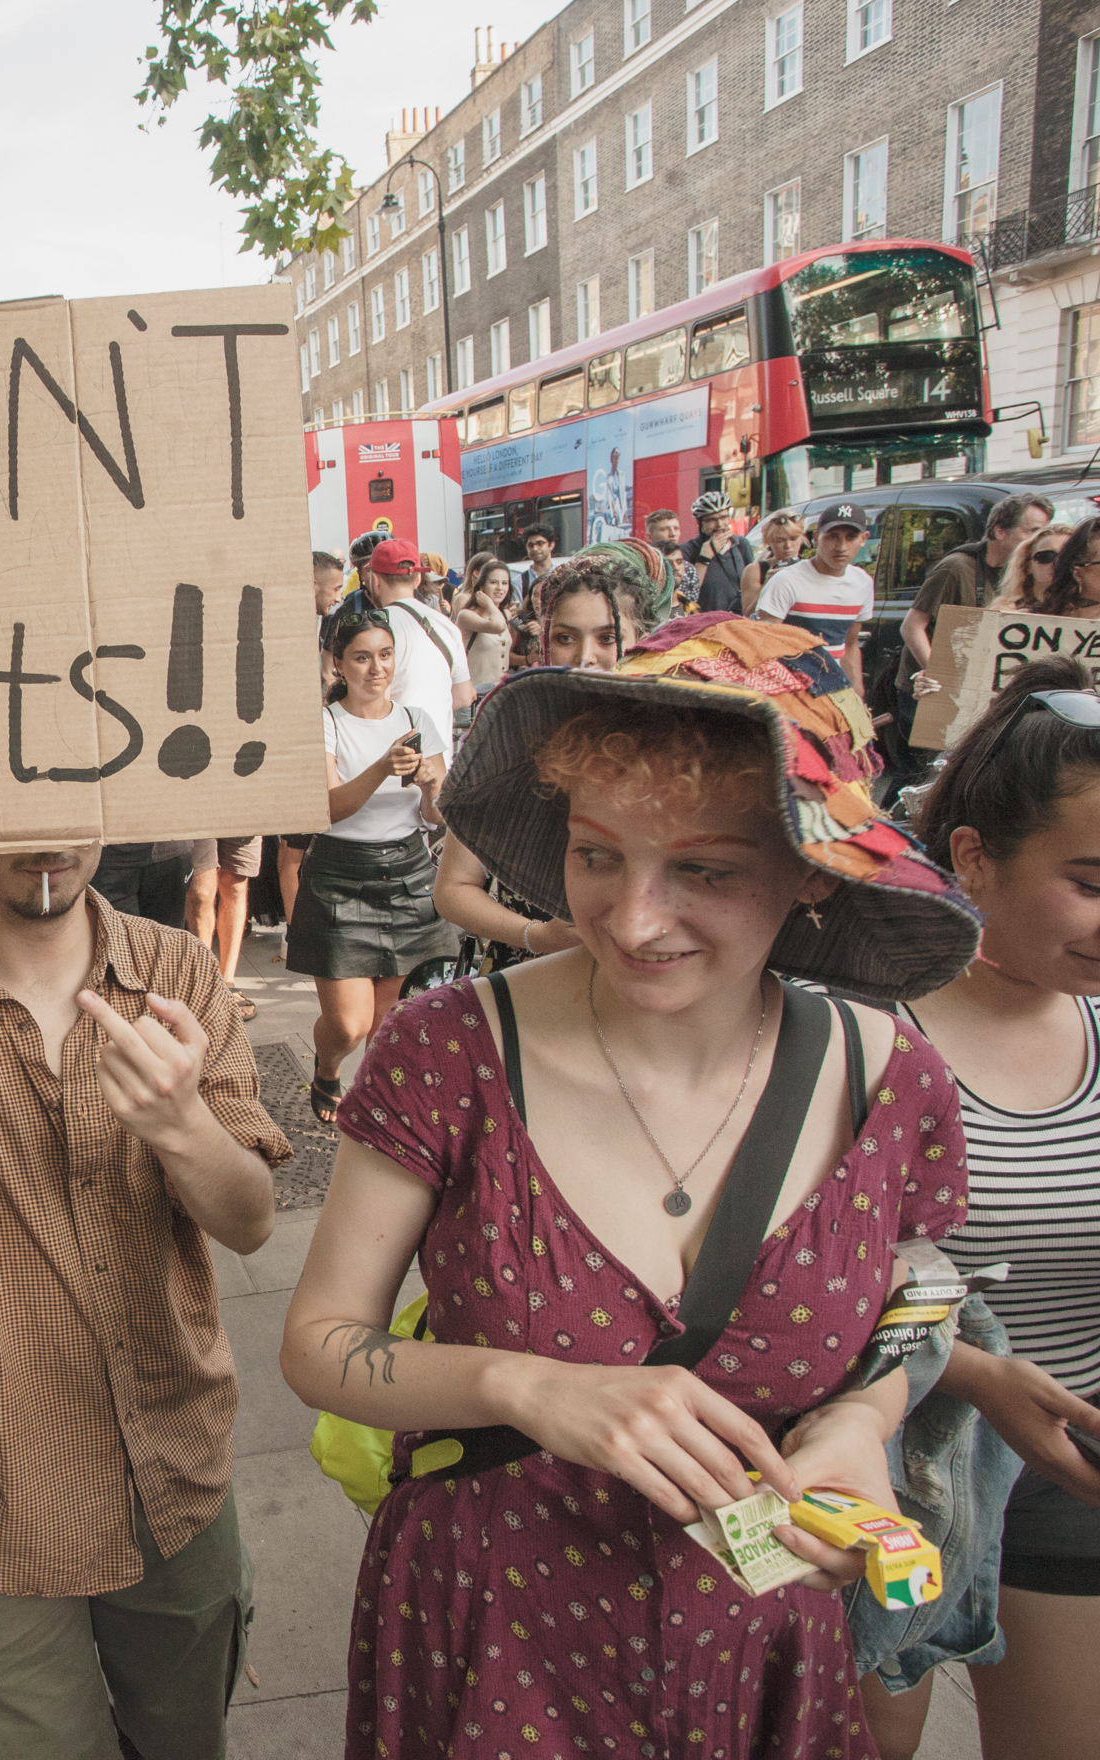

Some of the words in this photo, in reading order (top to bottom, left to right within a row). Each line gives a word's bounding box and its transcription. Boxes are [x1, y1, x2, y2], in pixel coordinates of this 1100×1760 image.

[810, 387, 853, 405] Russell
[857, 385, 899, 404] Square
[923, 376, 951, 402] 14
[639, 415, 677, 431] GUNWHARF
[678, 407, 702, 422] QUAYS
[945, 410, 977, 419] WHV138
[499, 454, 529, 470] DIFFERENT
[837, 505, 853, 518] NY
[999, 623, 1063, 652] ON
[906, 1290, 927, 1298] PAID
[929, 1288, 951, 1297] DUTY
[954, 1288, 965, 1297] UK
[915, 1327, 927, 1340] of
[879, 1344, 899, 1356] the
[883, 1534, 916, 1550] SWAN
